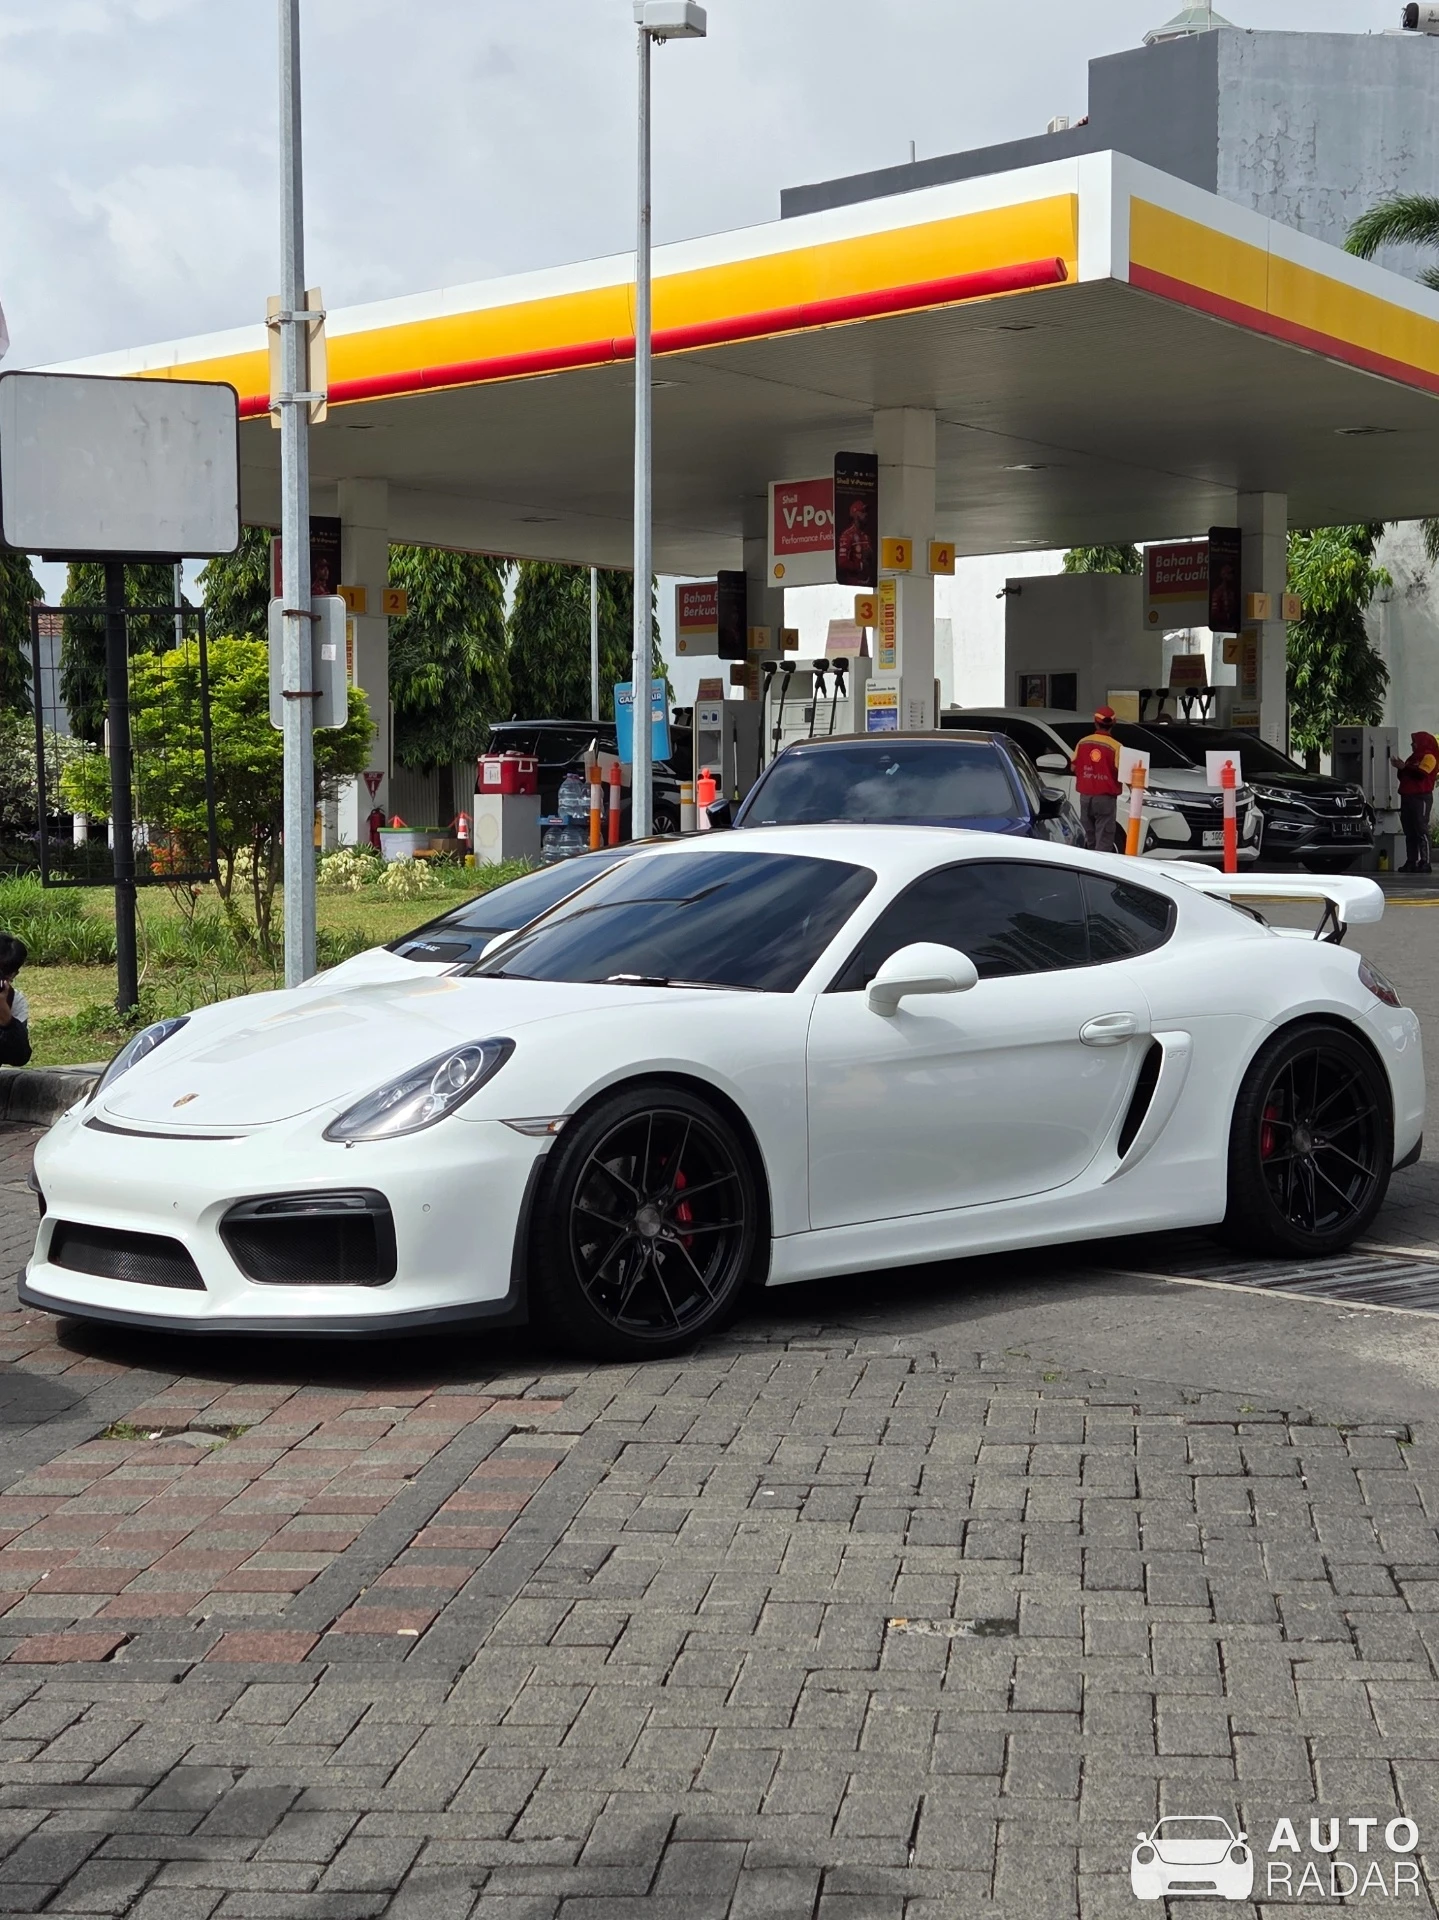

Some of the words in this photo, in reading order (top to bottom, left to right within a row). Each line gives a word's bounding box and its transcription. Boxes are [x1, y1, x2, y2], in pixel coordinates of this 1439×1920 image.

[782, 494, 798, 504] Shell
[781, 534, 819, 545] Performance
[895, 544, 905, 563] 3
[938, 549, 949, 567] 4
[1155, 554, 1193, 568] Bahan
[349, 592, 354, 607] 1
[389, 593, 399, 609] 2
[684, 592, 711, 604] Bahan
[860, 602, 874, 620] 3
[1258, 600, 1265, 613] 7
[1288, 600, 1295, 614] 8
[758, 631, 764, 645] 5
[786, 632, 794, 646] 6
[1227, 645, 1238, 658] 7
[619, 696, 633, 704] GAL
[1204, 832, 1208, 841] L
